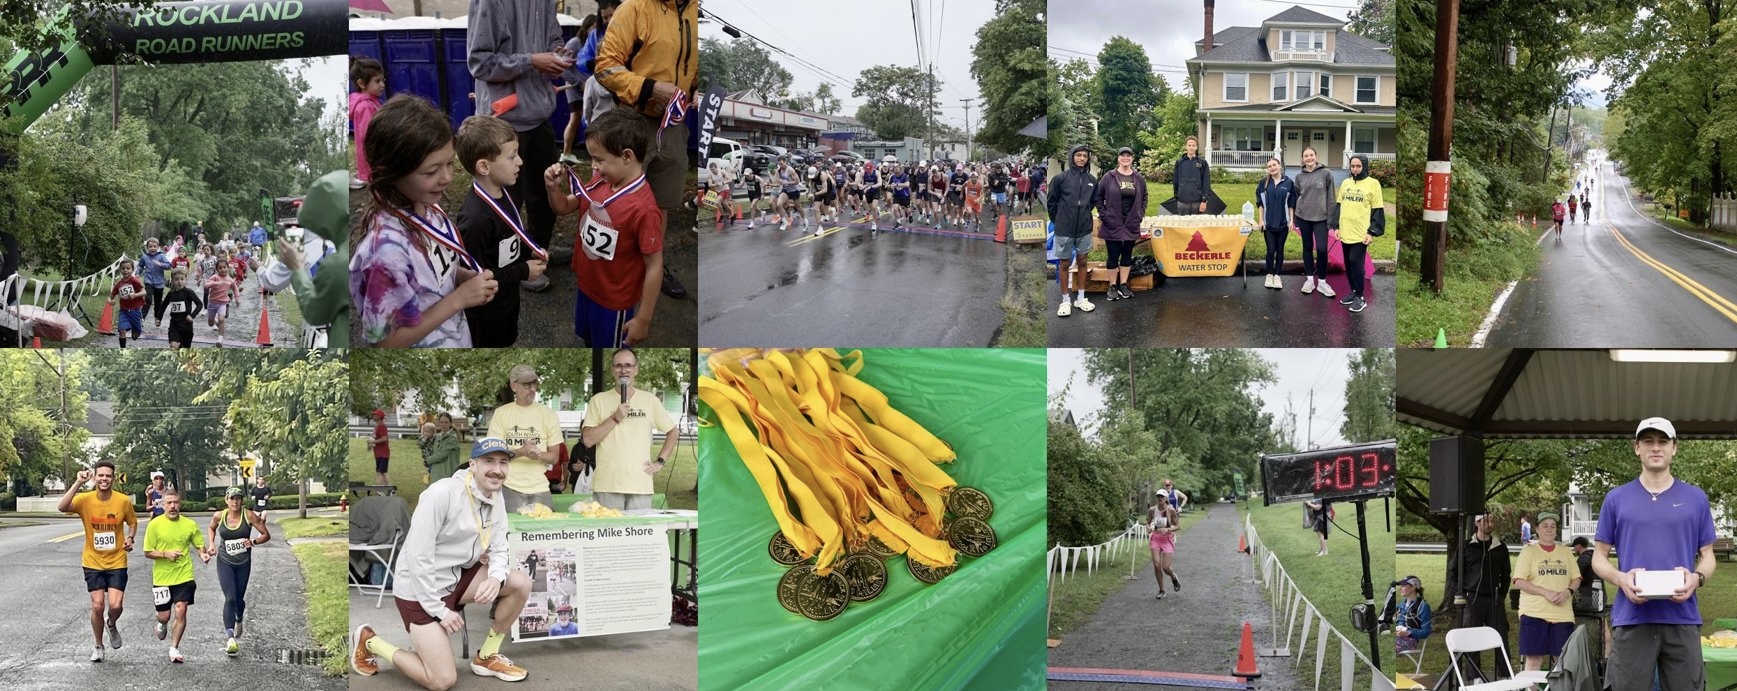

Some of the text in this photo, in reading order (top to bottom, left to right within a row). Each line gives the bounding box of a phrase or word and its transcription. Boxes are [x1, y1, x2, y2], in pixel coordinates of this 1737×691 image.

[134, 0, 304, 27] ROCKLAND
[135, 31, 305, 55] ROAD RUNNERS
[698, 93, 720, 159] START
[1014, 221, 1042, 229] START
[1175, 252, 1231, 260] BECKERLE
[172, 303, 181, 311] 97
[521, 527, 654, 541] Remembering Mike Shore
[94, 535, 115, 545] 5930
[226, 542, 244, 552] 5803
